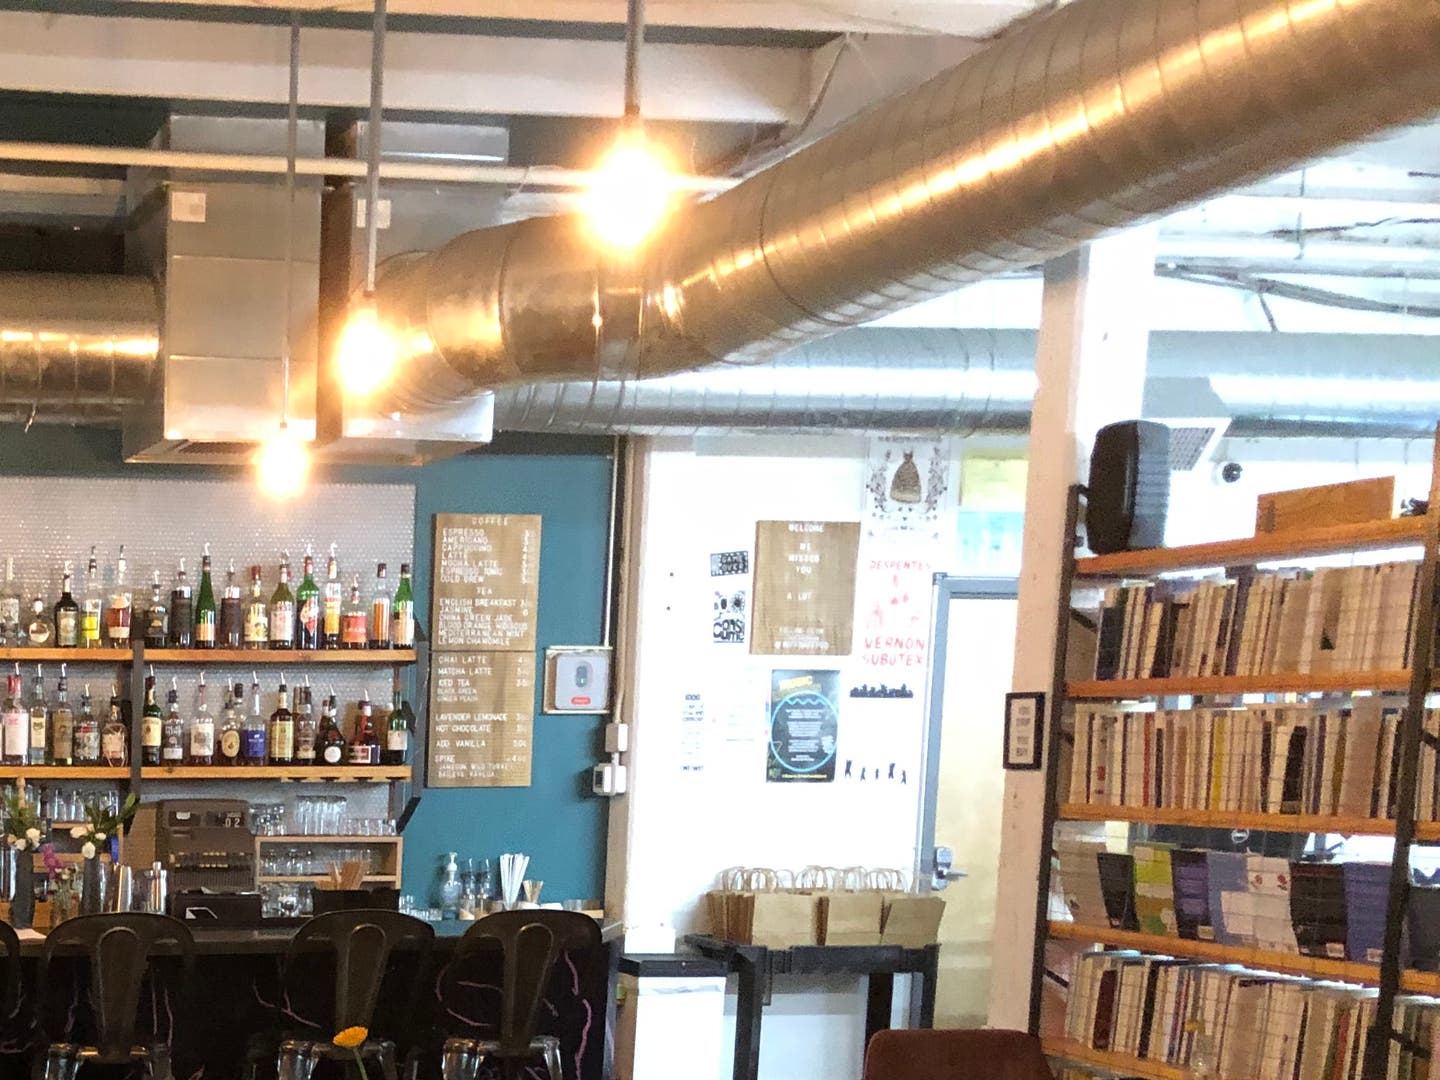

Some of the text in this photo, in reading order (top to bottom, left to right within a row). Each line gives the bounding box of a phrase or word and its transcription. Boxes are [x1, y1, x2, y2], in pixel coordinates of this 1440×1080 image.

[471, 516, 508, 526] COFFEE
[442, 527, 485, 537] ESPRESSO
[788, 523, 825, 533] WELCOME
[441, 551, 468, 560] LATTE
[795, 565, 812, 575] YOU
[476, 586, 493, 595] TEA
[474, 598, 517, 607] BREAKFAST
[864, 636, 926, 650] VERNON
[438, 655, 488, 665] CHAI LATTE
[862, 652, 923, 666] SUBUTEX
[437, 667, 493, 676] MATCHA LATTE
[457, 678, 470, 688] TEA
[435, 712, 472, 721] LAVENDER
[473, 712, 508, 722] LEMONADE
[435, 723, 492, 734] HOT CHOCOLATE
[455, 739, 487, 749] VANILLA
